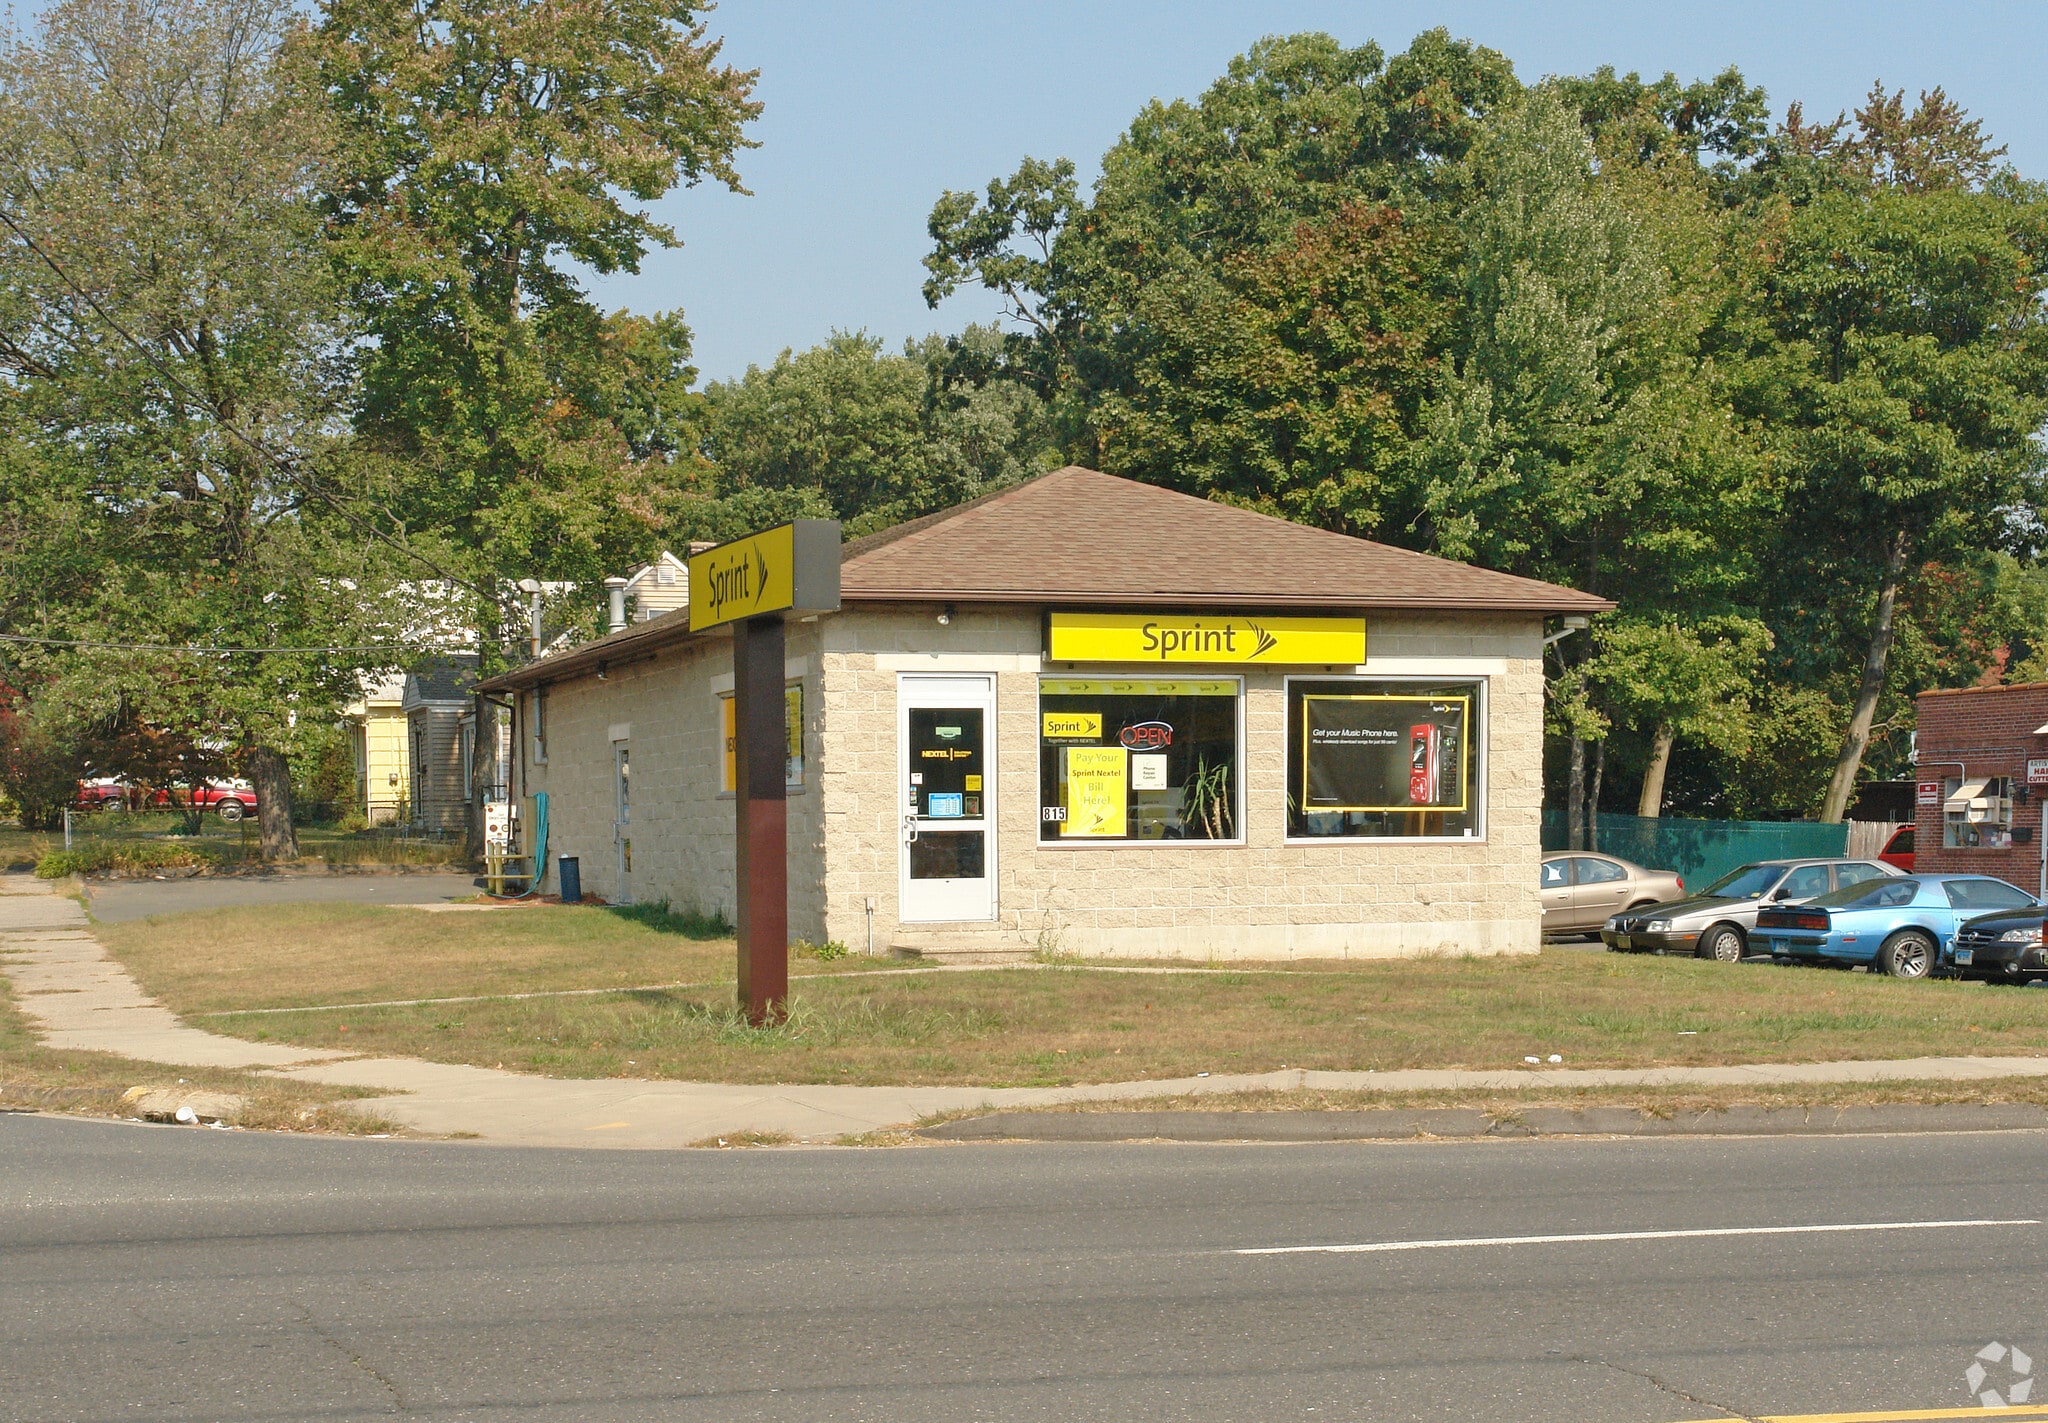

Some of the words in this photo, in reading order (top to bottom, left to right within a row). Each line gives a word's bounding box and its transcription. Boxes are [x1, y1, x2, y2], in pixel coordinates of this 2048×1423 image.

[709, 552, 749, 619] Sprint
[1142, 622, 1236, 659] Sprint
[1048, 720, 1080, 734] Sprint
[1120, 726, 1172, 746] OPEN
[1312, 728, 1326, 737] Get
[1326, 730, 1341, 738] your
[1341, 728, 1361, 737] Music
[1361, 729, 1382, 737] Phone
[1383, 729, 1399, 737] here.
[922, 750, 949, 758] NEXTEL
[1076, 753, 1094, 764] Pay
[1096, 753, 1119, 762] Your
[1072, 769, 1095, 778] Sprint
[1096, 769, 1121, 777] Nextel
[1088, 782, 1104, 791] Bill
[1083, 796, 1111, 805] Here!
[1044, 807, 1065, 820] 815
